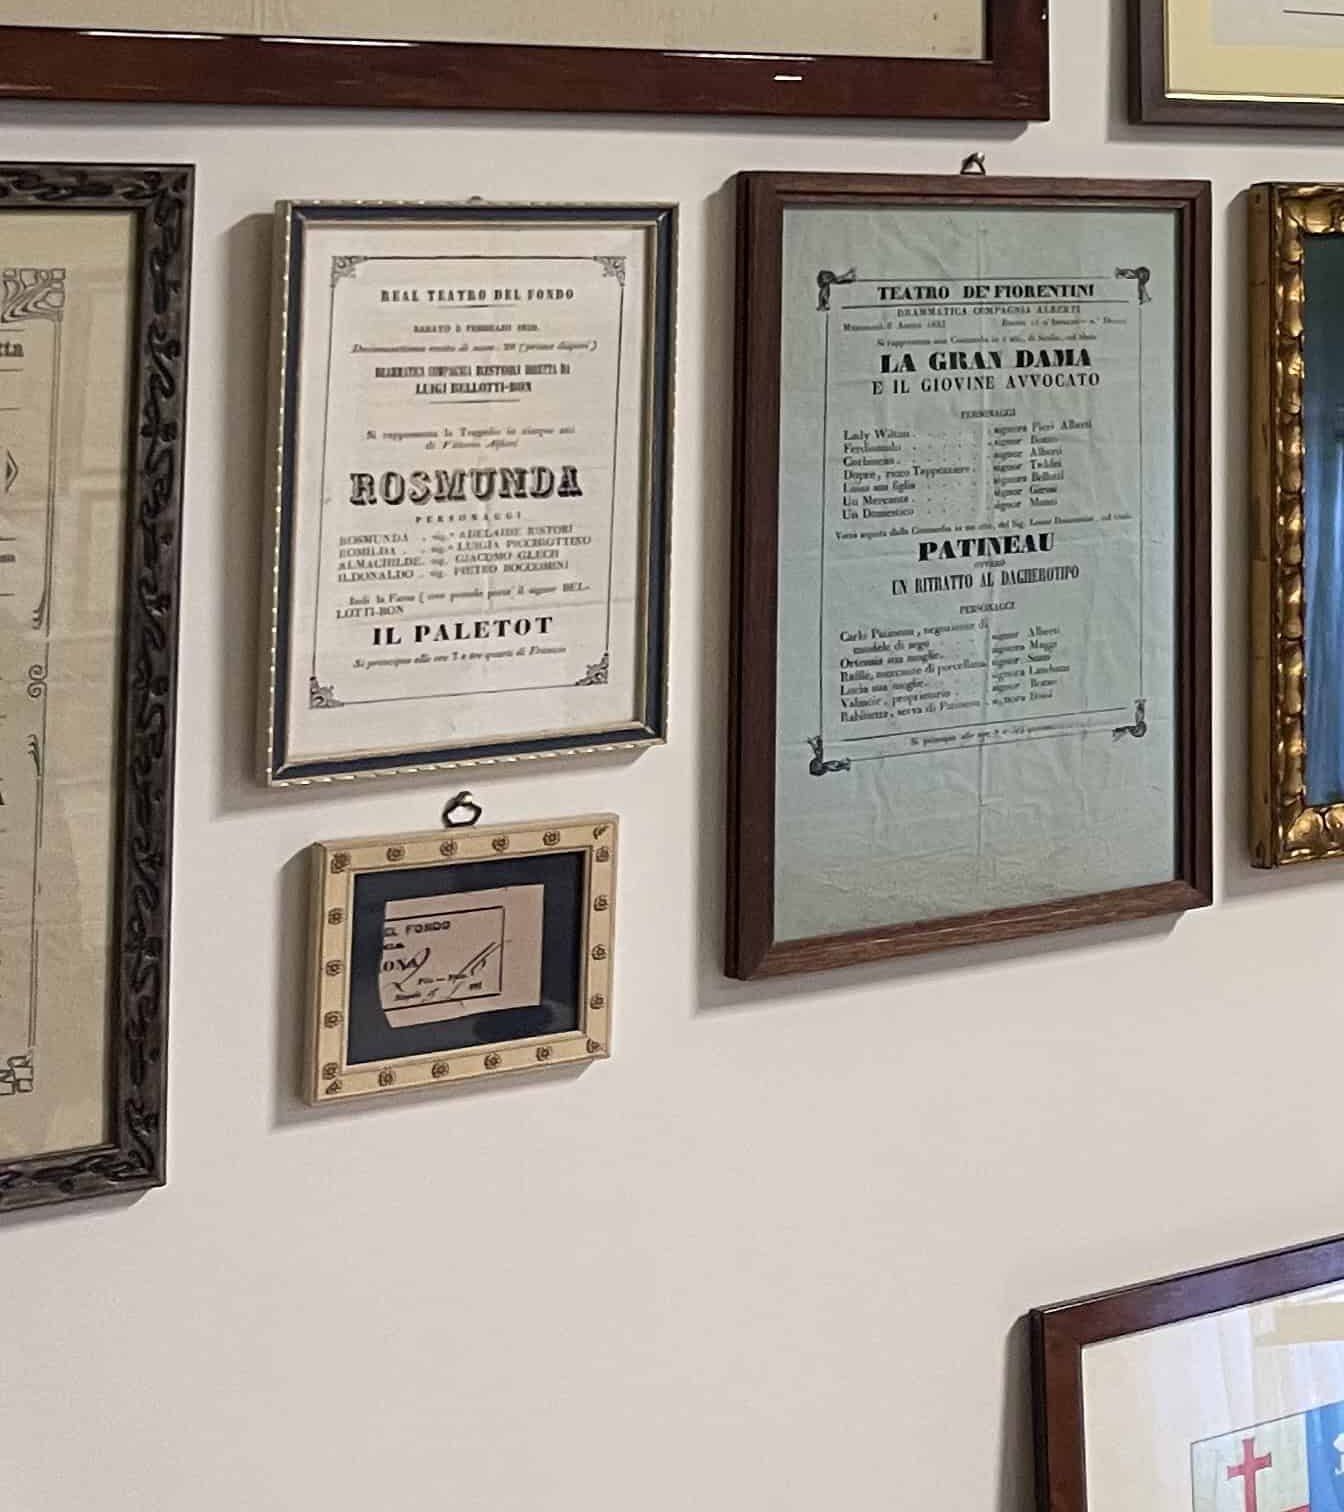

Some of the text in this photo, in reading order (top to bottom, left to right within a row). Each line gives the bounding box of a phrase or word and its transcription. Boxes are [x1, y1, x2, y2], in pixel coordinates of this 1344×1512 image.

[381, 288, 574, 303] REAL TEATRO DEL FONDO
[877, 285, 950, 301] TEATRO
[993, 284, 1094, 298] FIORENTINI
[880, 348, 1092, 374] LA GRAN DAMA
[872, 372, 1100, 395] E IL GIOVINE AVVOCATO
[349, 465, 583, 506] ROSMUNDA
[338, 532, 409, 546] ROSMUNDA
[918, 532, 1055, 562] PATINEAU
[892, 565, 1080, 595] UN RITRATTO AL DAGHEROTIPO
[372, 617, 553, 646] IL PALETOT
